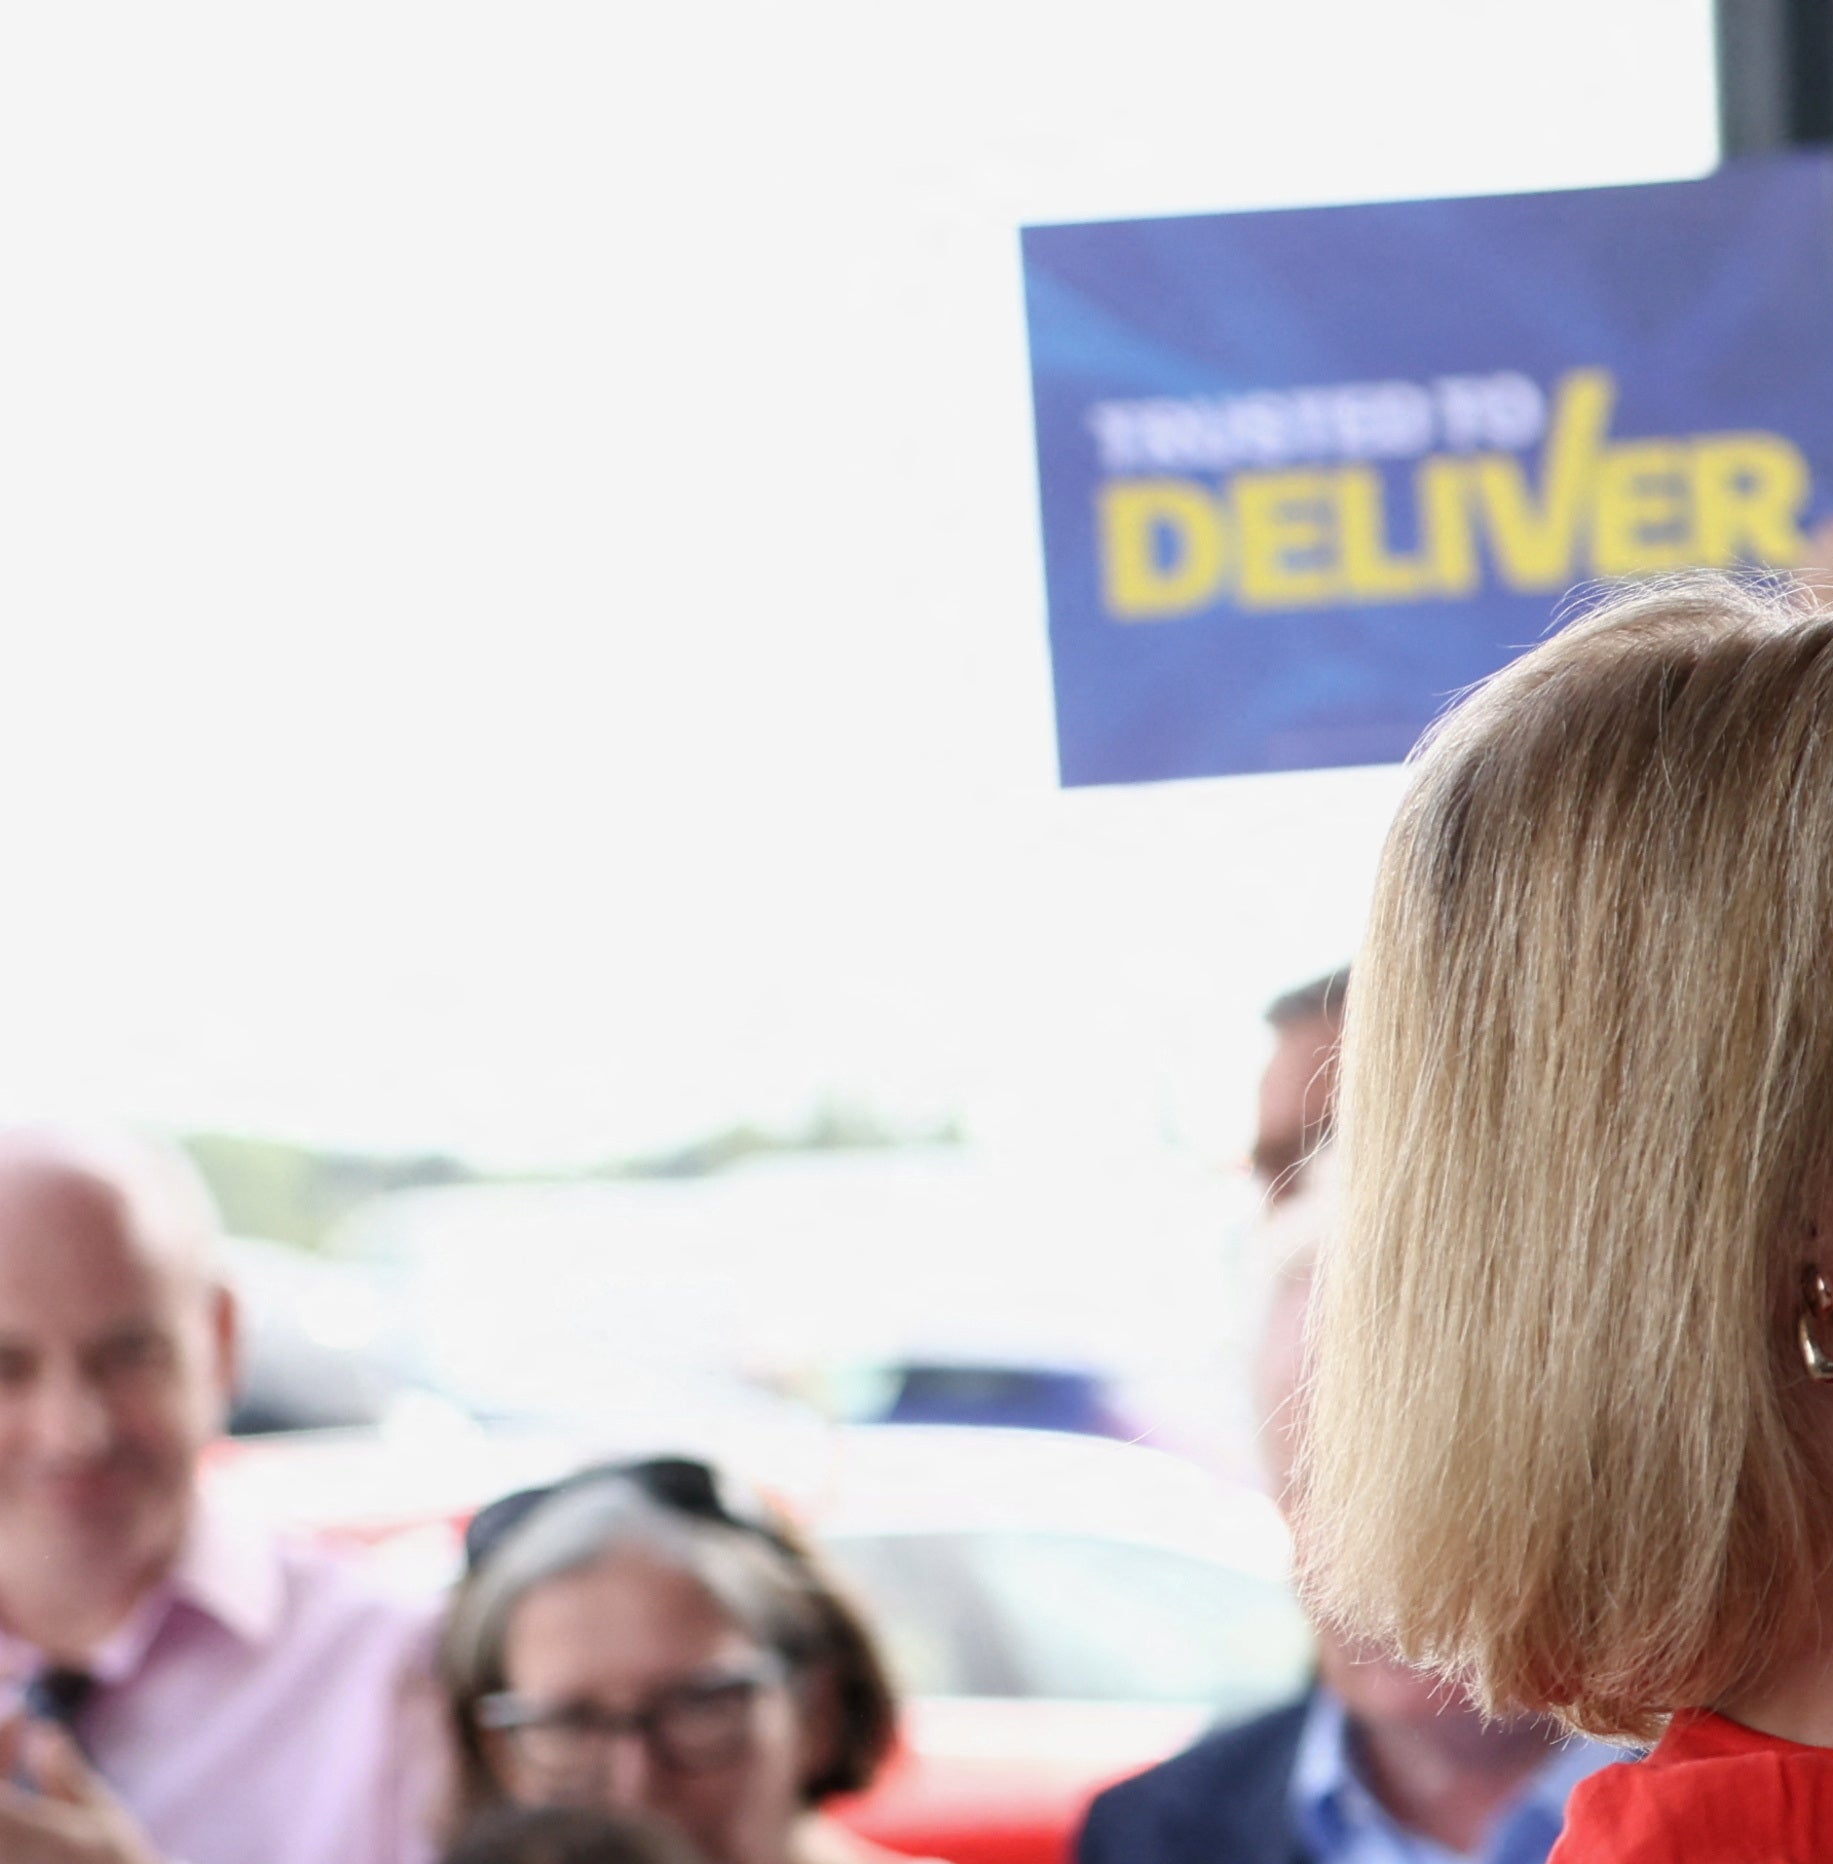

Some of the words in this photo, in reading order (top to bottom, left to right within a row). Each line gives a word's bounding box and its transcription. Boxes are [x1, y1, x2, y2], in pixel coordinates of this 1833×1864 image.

[1092, 382, 1431, 470] TRUSTED
[1435, 370, 1547, 453] TO
[1097, 369, 1811, 624] DELIVER
